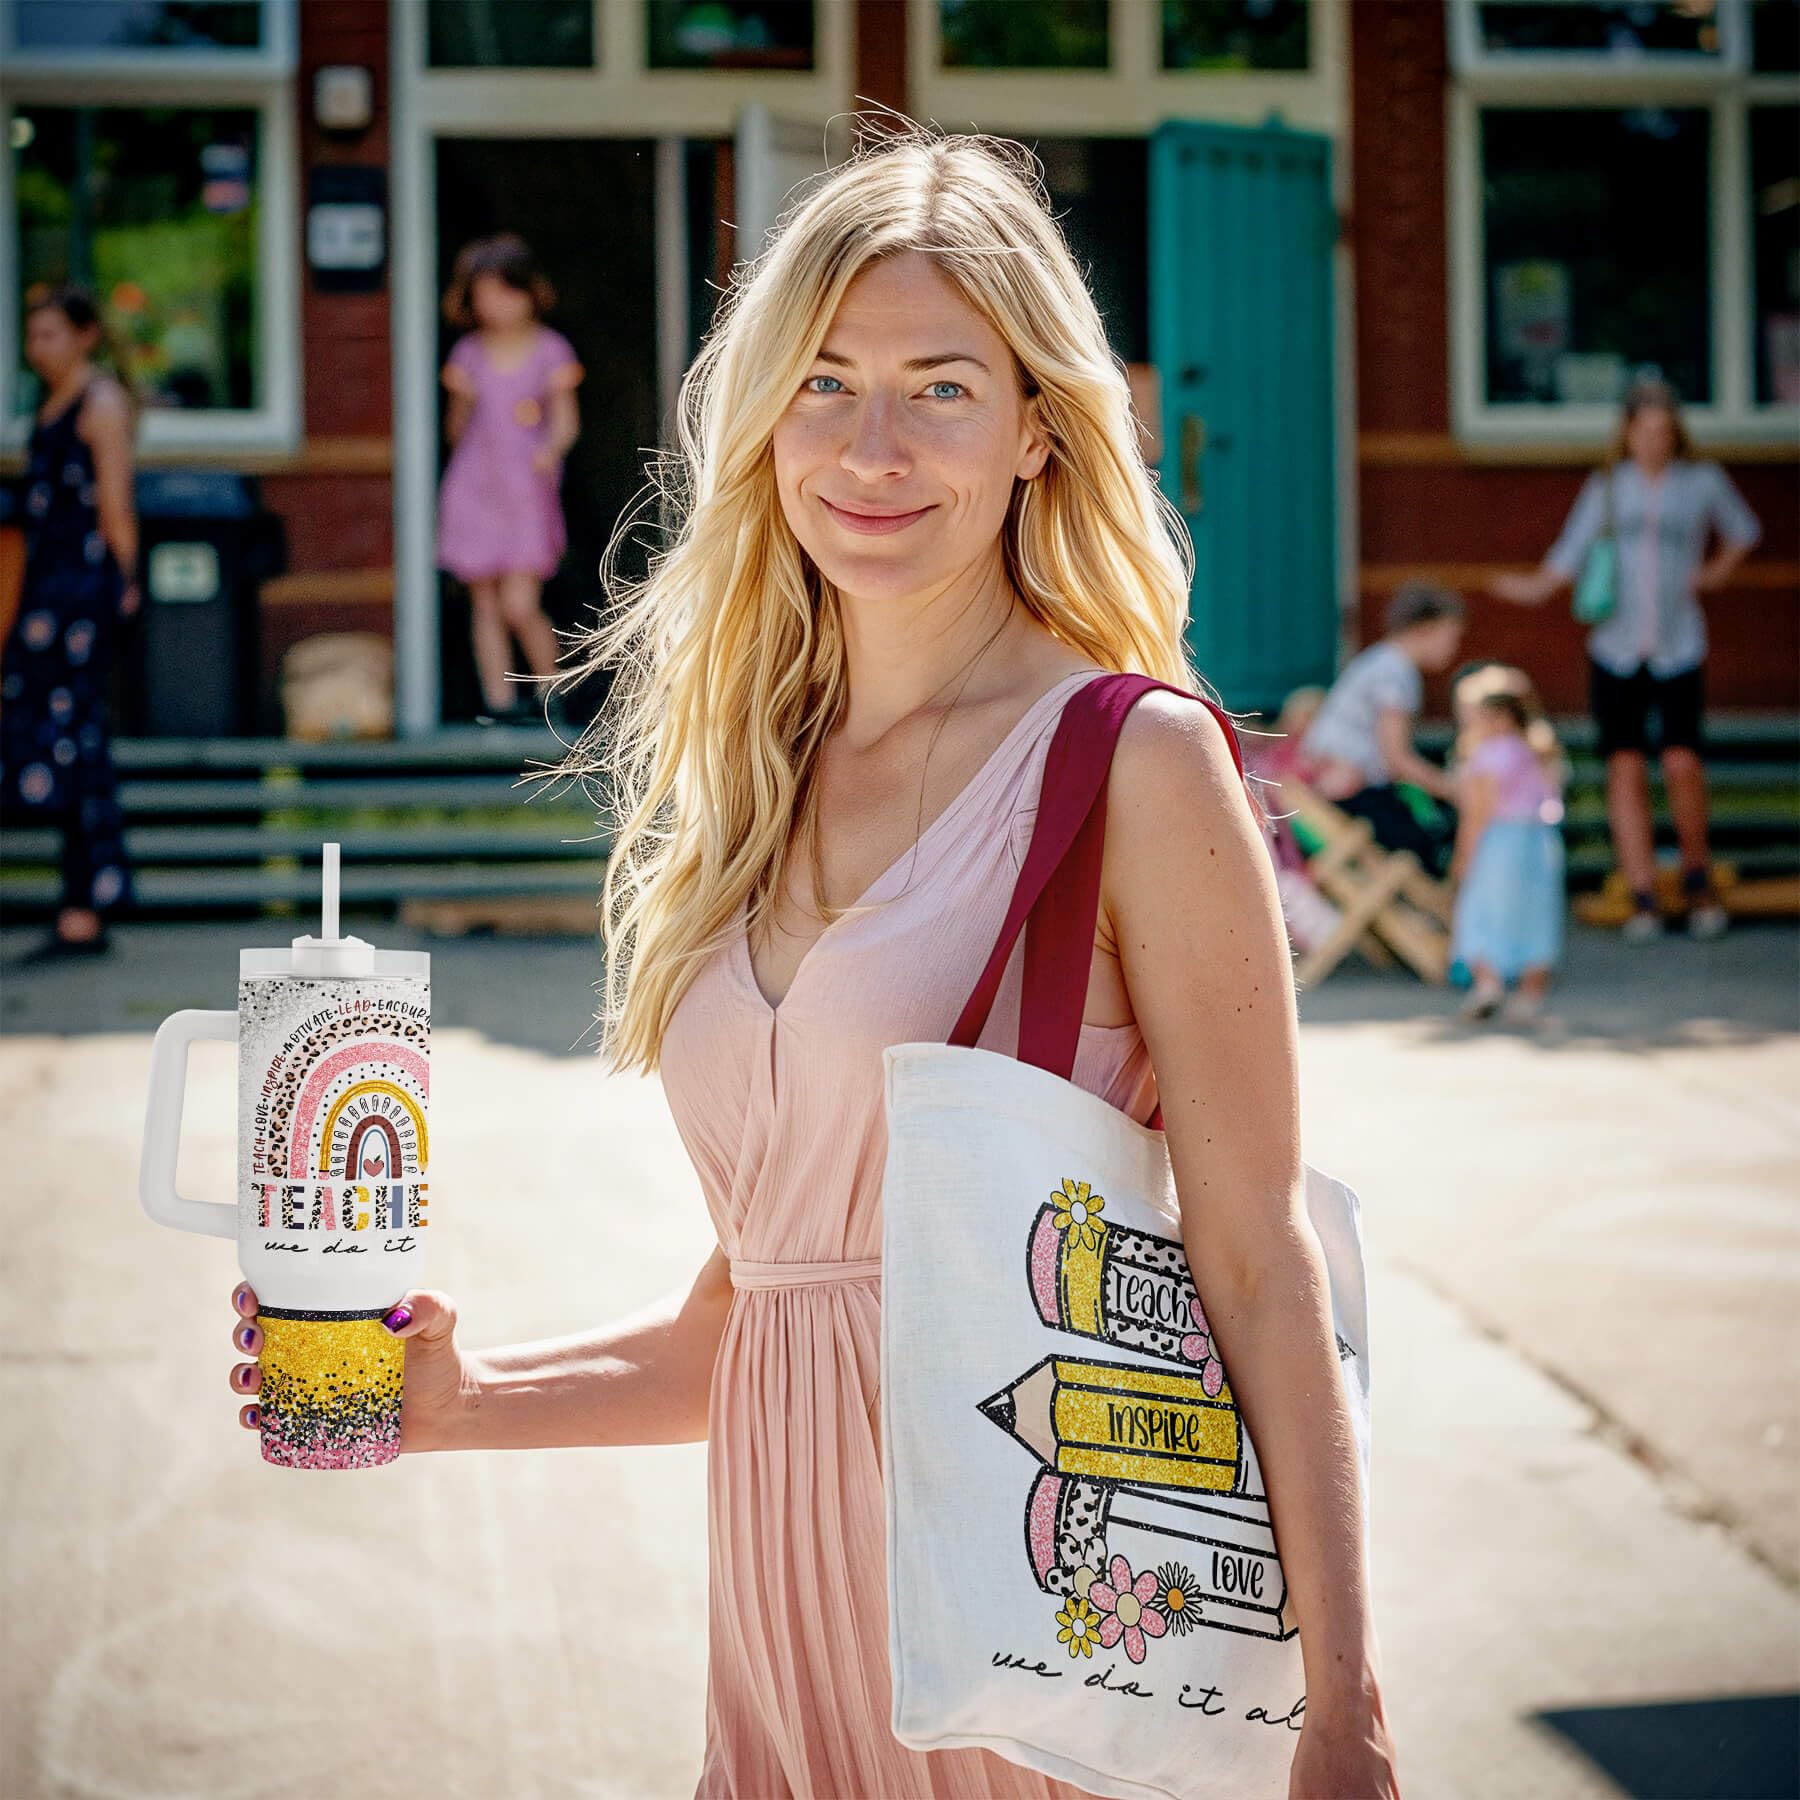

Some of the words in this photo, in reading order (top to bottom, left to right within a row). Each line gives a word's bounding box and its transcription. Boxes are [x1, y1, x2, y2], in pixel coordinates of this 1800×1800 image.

[338, 999, 371, 1015] LEAD
[283, 1008, 334, 1053] MOTIVATE
[260, 1054, 288, 1098] INSPIRE
[254, 1103, 269, 1132] LOVE
[252, 1138, 268, 1175] TEACH
[264, 1240, 309, 1253] we
[322, 1238, 368, 1254] do
[383, 1235, 417, 1252] it
[1111, 1265, 1188, 1329] Teach
[992, 1651, 1063, 1677] we
[1084, 1664, 1154, 1697] do
[1178, 1686, 1226, 1716] it
